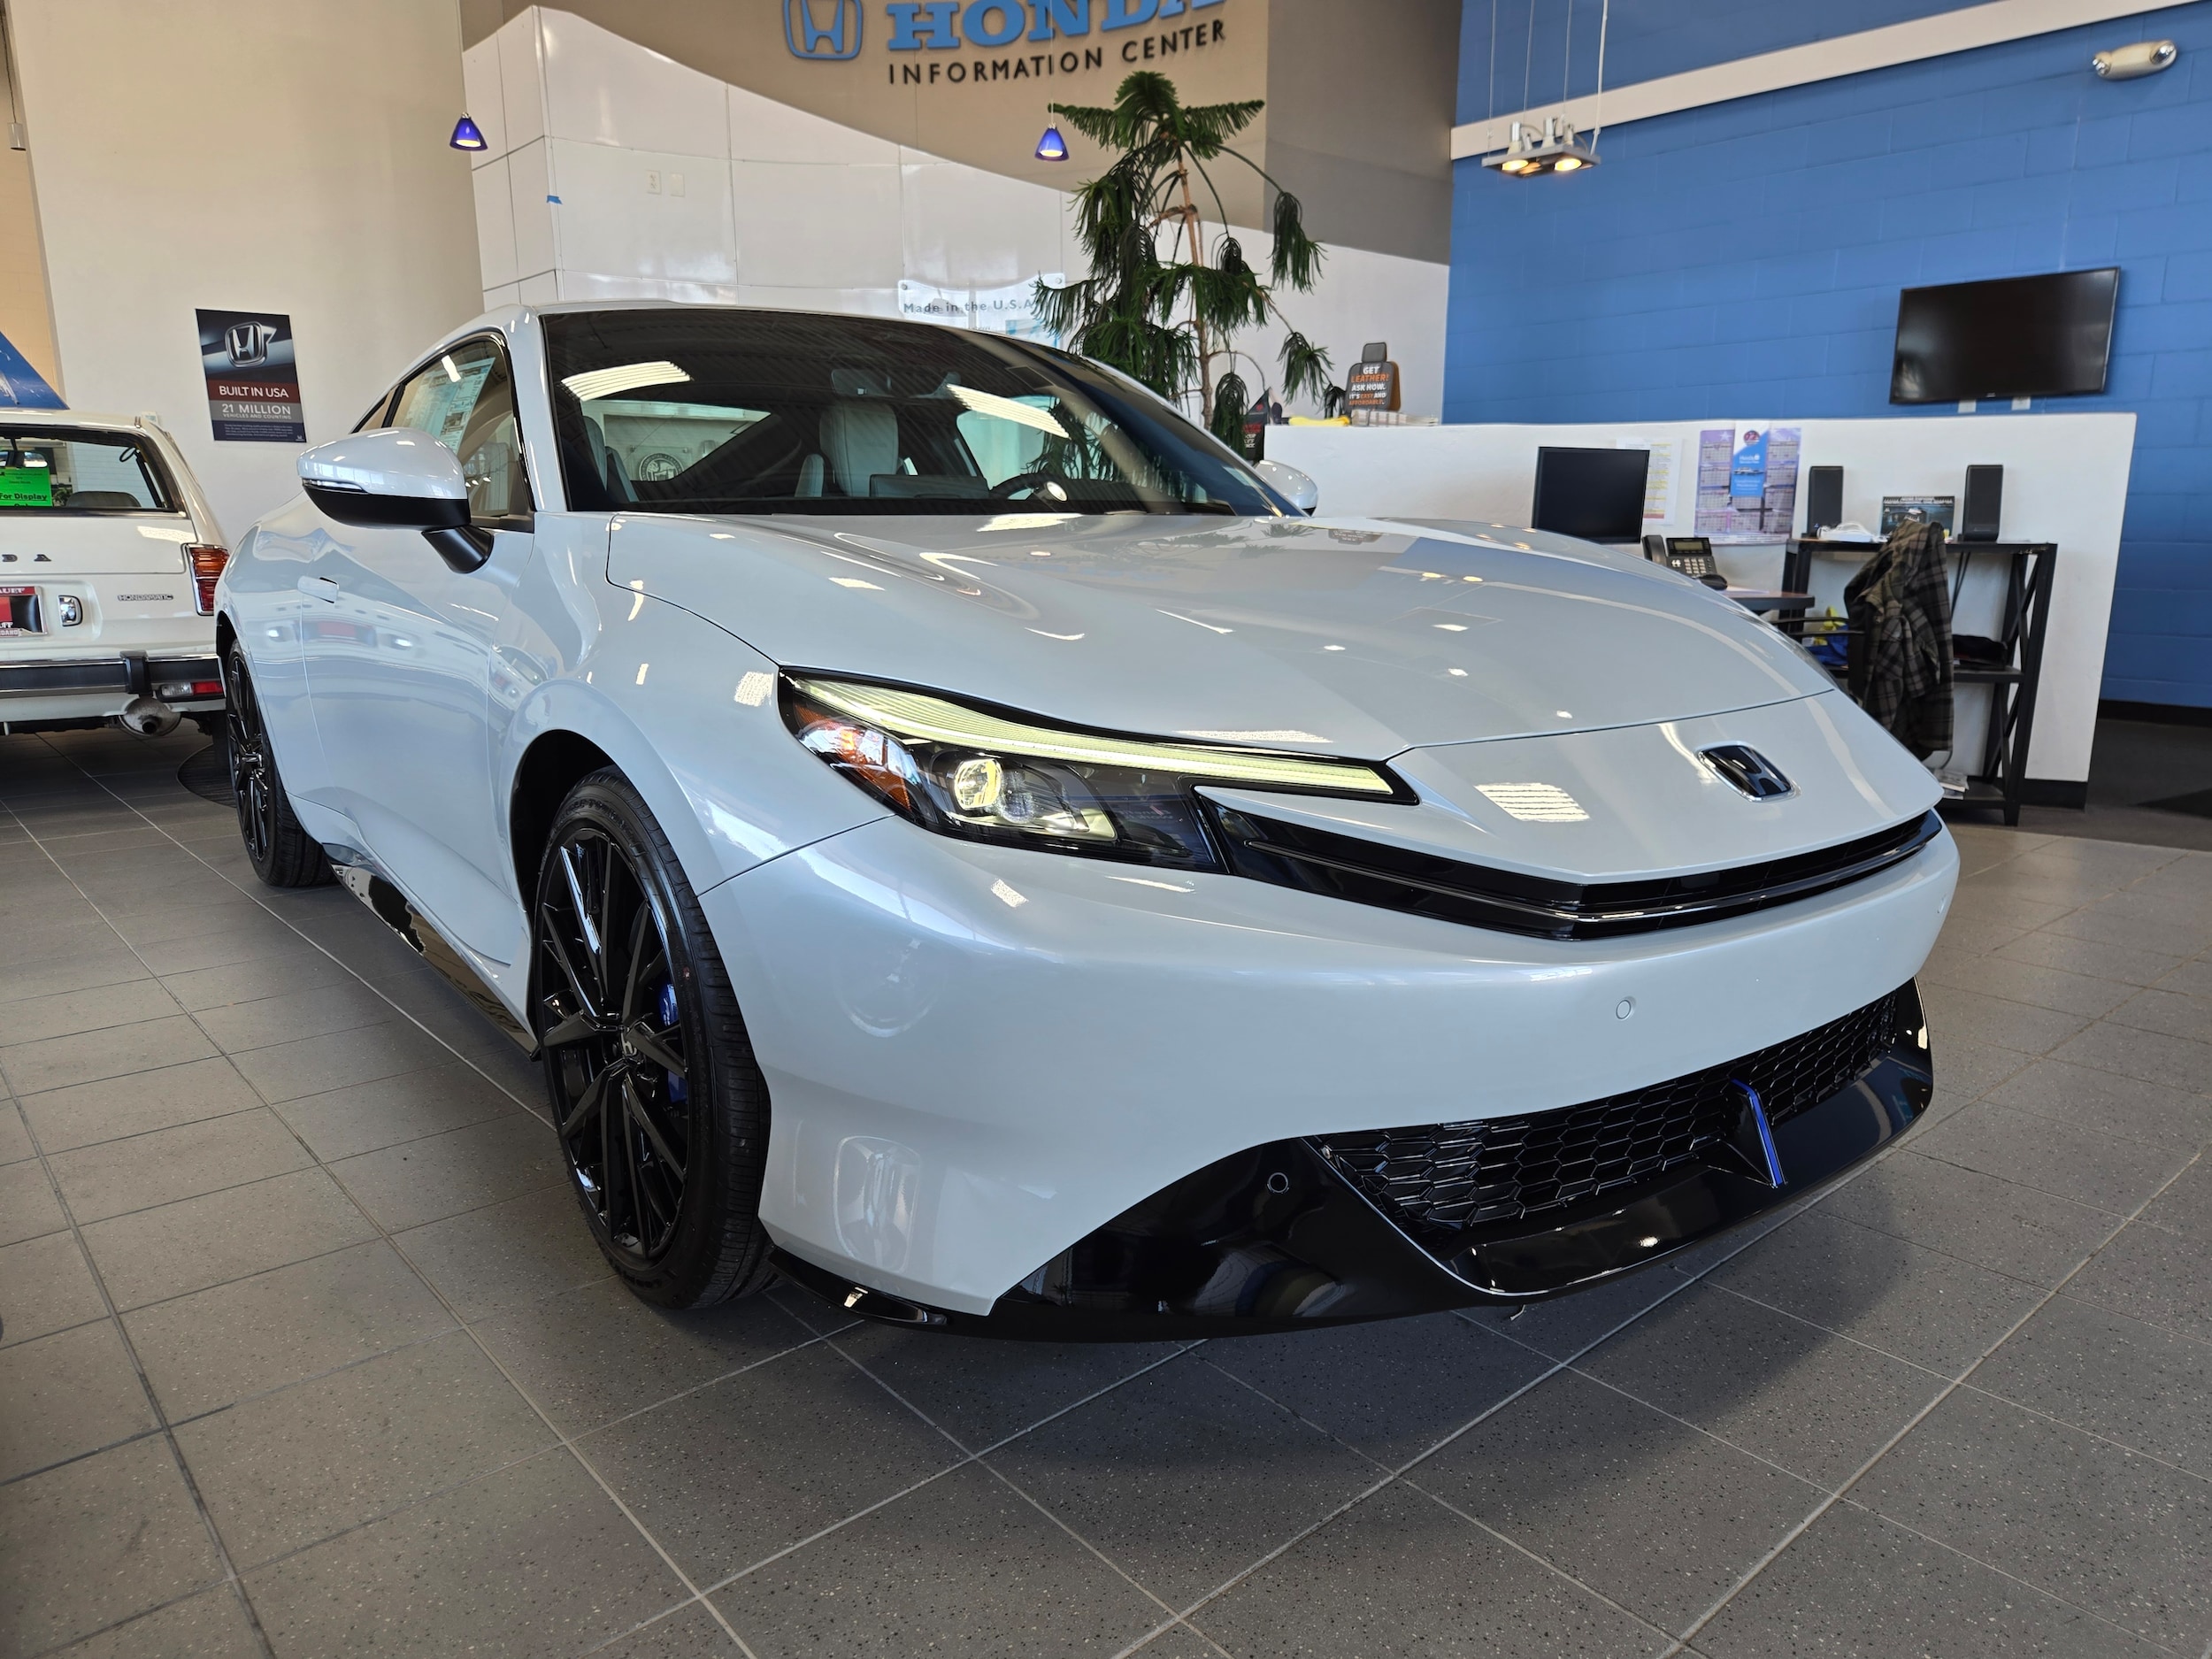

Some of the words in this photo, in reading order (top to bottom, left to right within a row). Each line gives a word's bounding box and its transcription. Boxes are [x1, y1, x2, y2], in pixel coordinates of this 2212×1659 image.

[889, 47, 1102, 85] INFORMATION
[1121, 19, 1225, 63] CENTER
[903, 303, 940, 313] Made
[946, 302, 959, 312] in
[964, 300, 987, 311] the
[1351, 373, 1389, 382] LEATHER!
[219, 385, 250, 396] BUILT
[250, 387, 264, 397] IN
[265, 388, 289, 398] USA
[221, 403, 234, 413] 21
[238, 403, 291, 415] MILLION
[14, 493, 48, 502] Display
